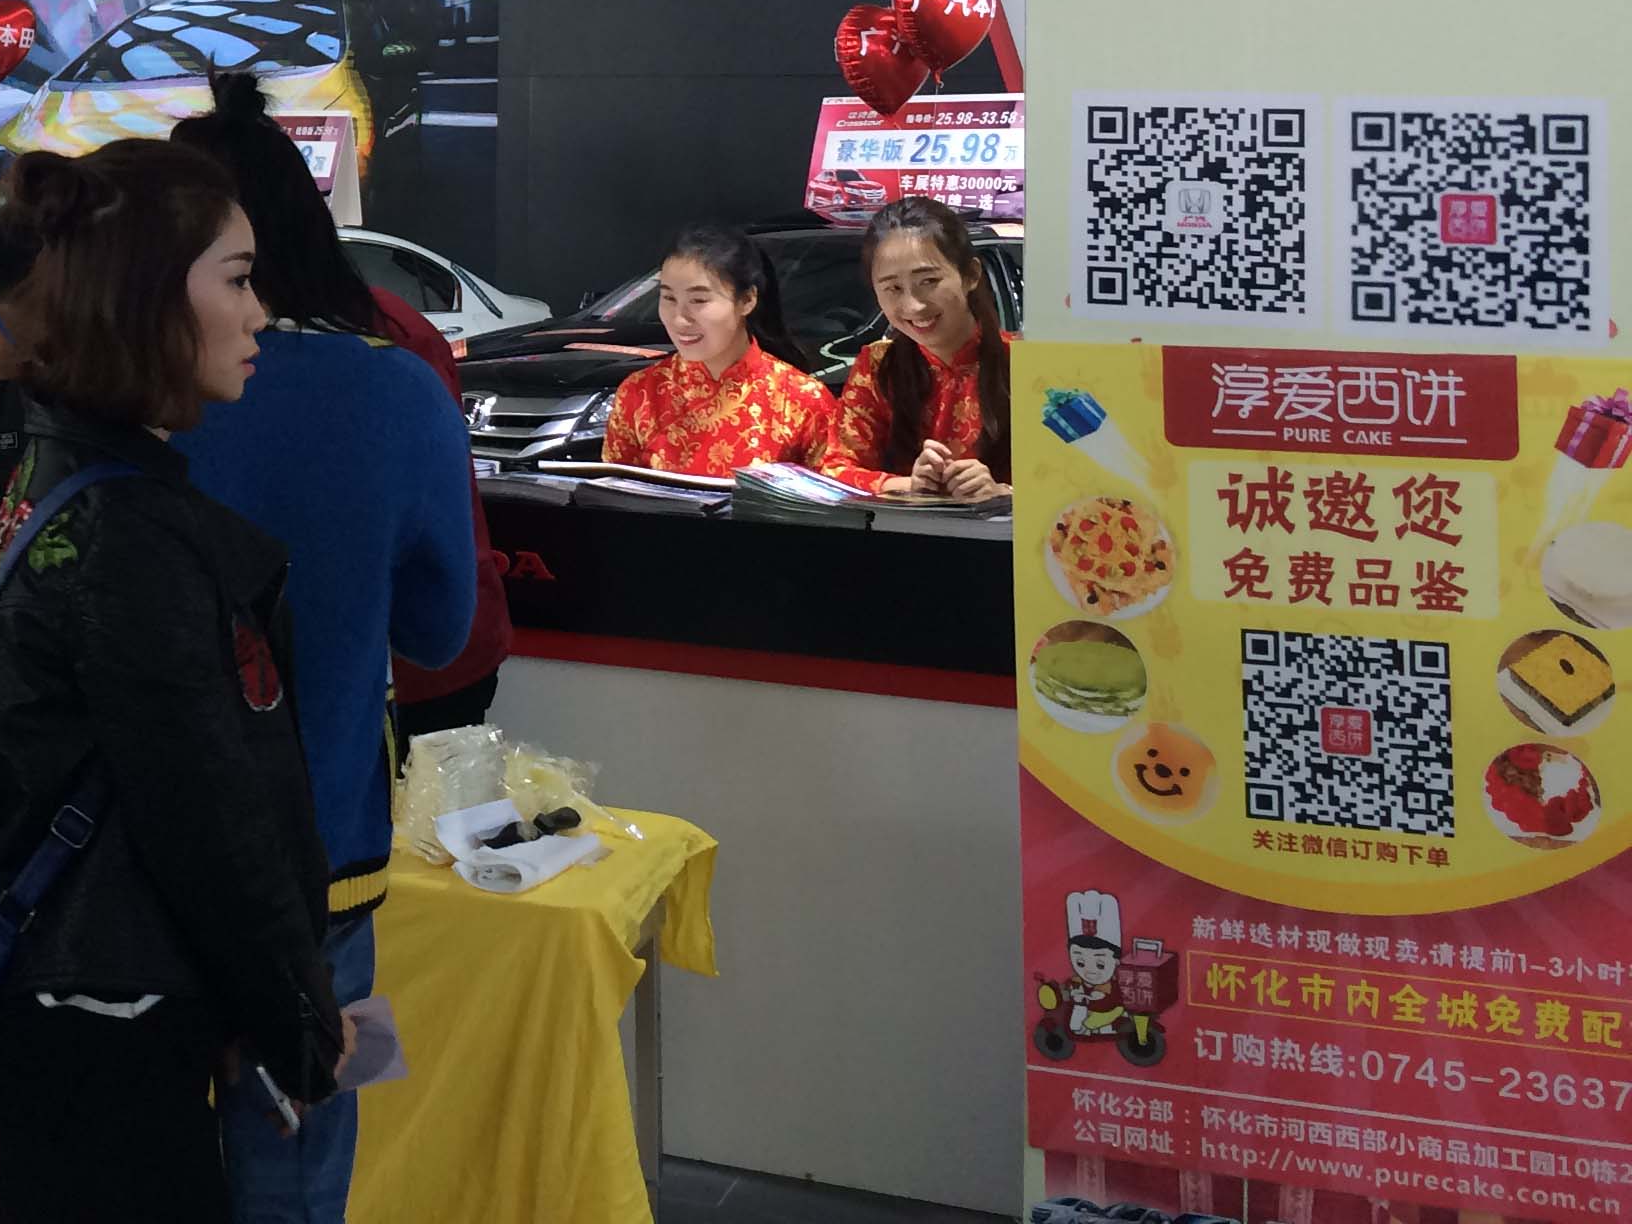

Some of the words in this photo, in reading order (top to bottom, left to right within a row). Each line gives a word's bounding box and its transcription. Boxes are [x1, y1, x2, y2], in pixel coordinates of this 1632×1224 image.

[936, 111, 1018, 126] 25.98-33.58
[837, 138, 905, 162] 豪华版
[910, 133, 1002, 164] 25.98
[900, 175, 1017, 192] 车展特惠30000元
[1211, 362, 1467, 428] 淳爱西饼
[1283, 427, 1331, 444] PURE
[1343, 428, 1393, 446] CAKE
[1217, 465, 1465, 547] 诚邀您
[1222, 547, 1469, 613] 免费品鉴
[1252, 830, 1451, 868] 关注微信订购下单
[1191, 915, 1632, 986] 新鲜选材现做现卖,请提前1-3小时
[1205, 962, 1632, 1049] 怀化市内全城免费配
